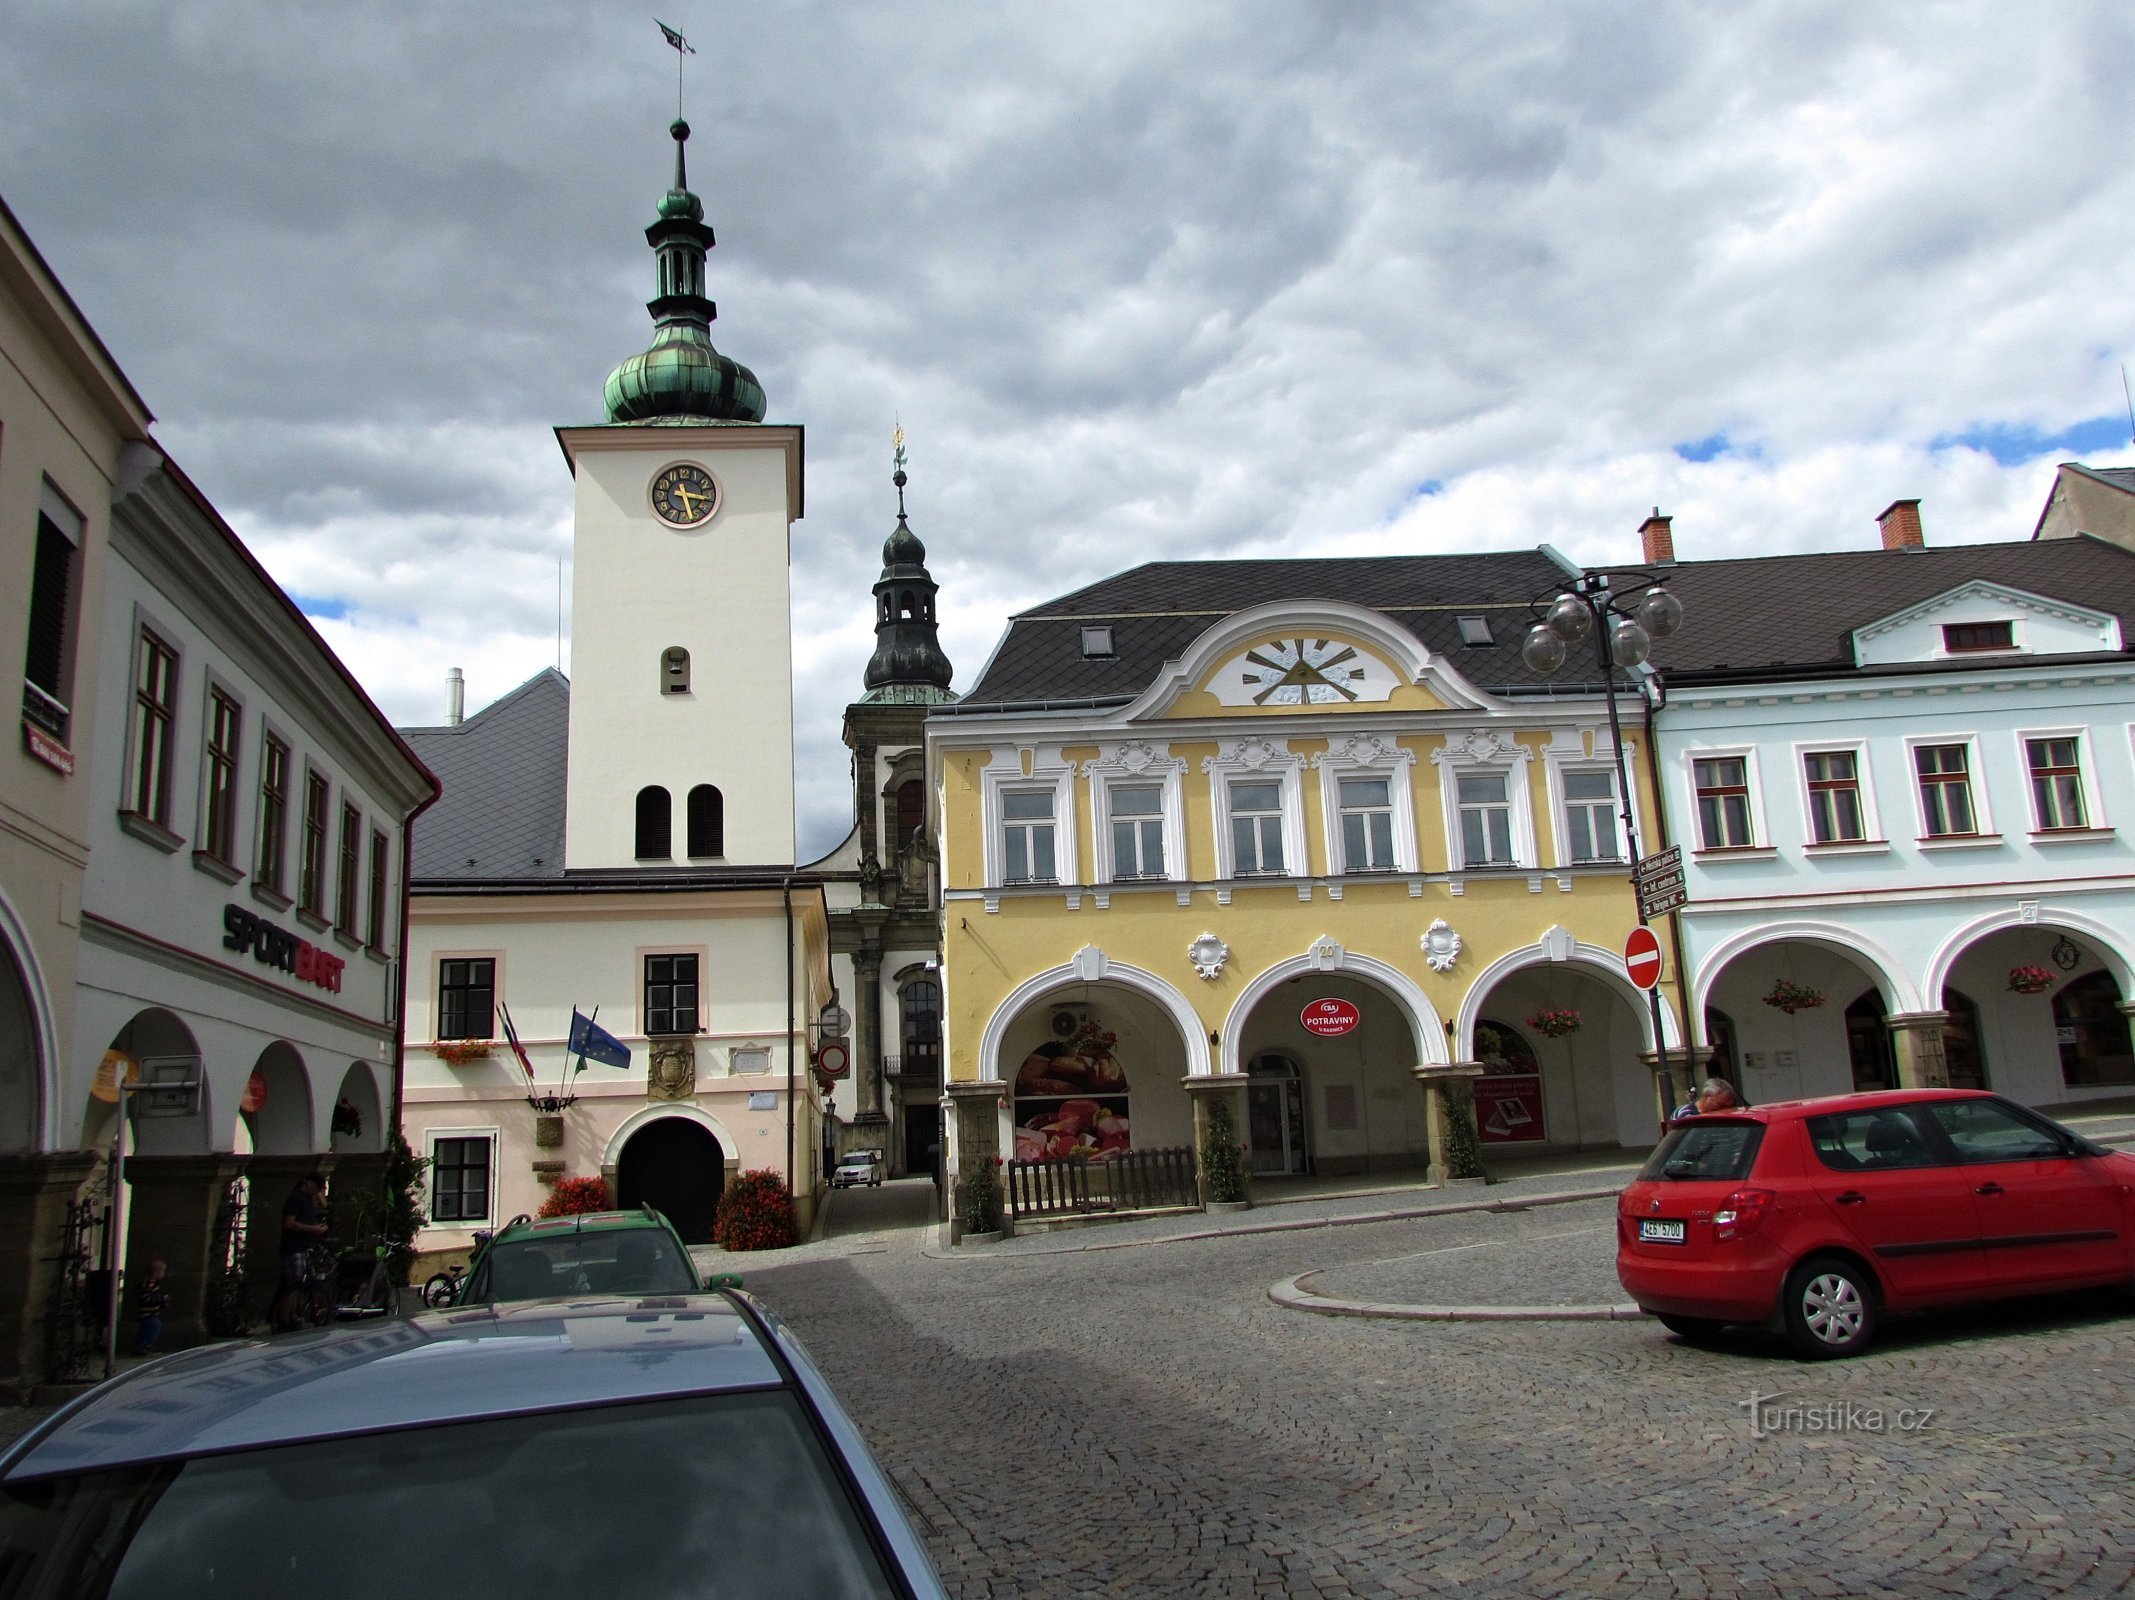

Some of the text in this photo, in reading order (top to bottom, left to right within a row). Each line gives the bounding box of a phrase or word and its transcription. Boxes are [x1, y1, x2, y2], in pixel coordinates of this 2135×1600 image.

[701, 479, 710, 489] 2
[657, 491, 665, 500] 9
[660, 502, 668, 510] 8
[669, 510, 677, 519] 7
[1657, 875, 1677, 890] centrum
[2022, 906, 2036, 918] 21
[1319, 946, 1334, 958] 20
[1323, 1004, 1337, 1012] CBA
[1307, 1016, 1354, 1025] POTRAVINY
[1662, 1222, 1680, 1237] 5700
